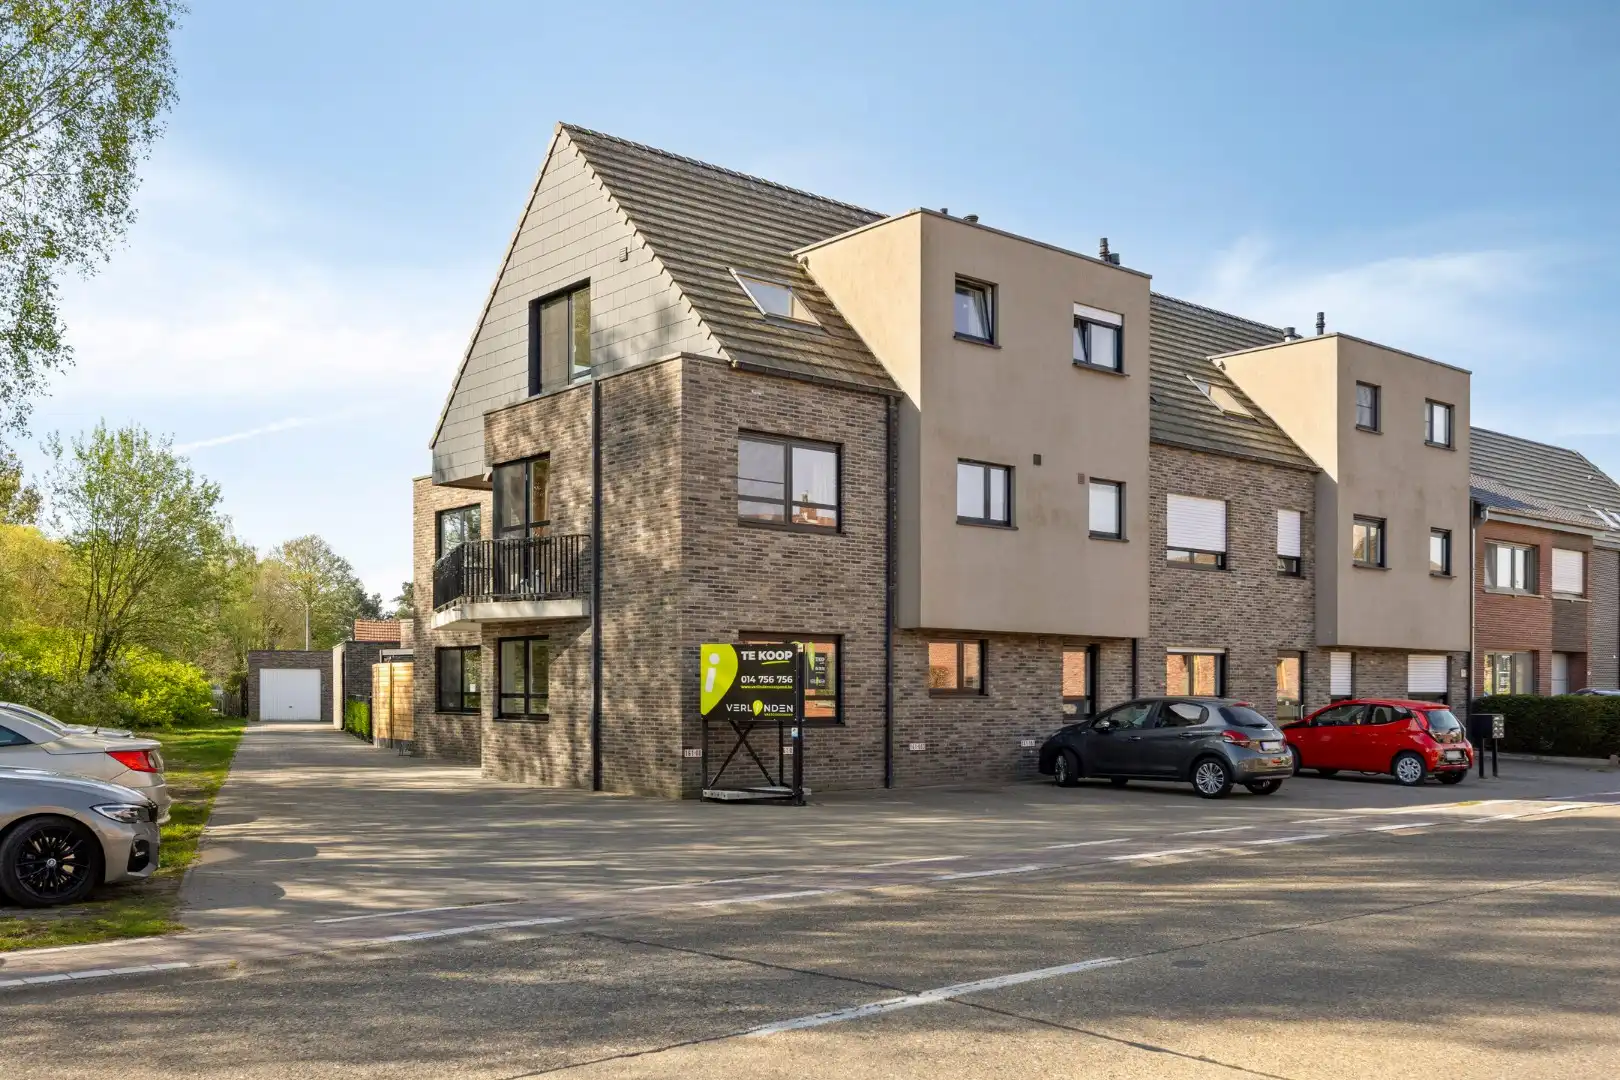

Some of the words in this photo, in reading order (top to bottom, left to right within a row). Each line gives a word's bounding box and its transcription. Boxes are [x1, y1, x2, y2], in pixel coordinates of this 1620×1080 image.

[741, 651, 756, 660] TE
[758, 651, 793, 660] KOOP
[740, 675, 756, 683] 014
[758, 675, 775, 683] 756
[776, 675, 793, 683] 756
